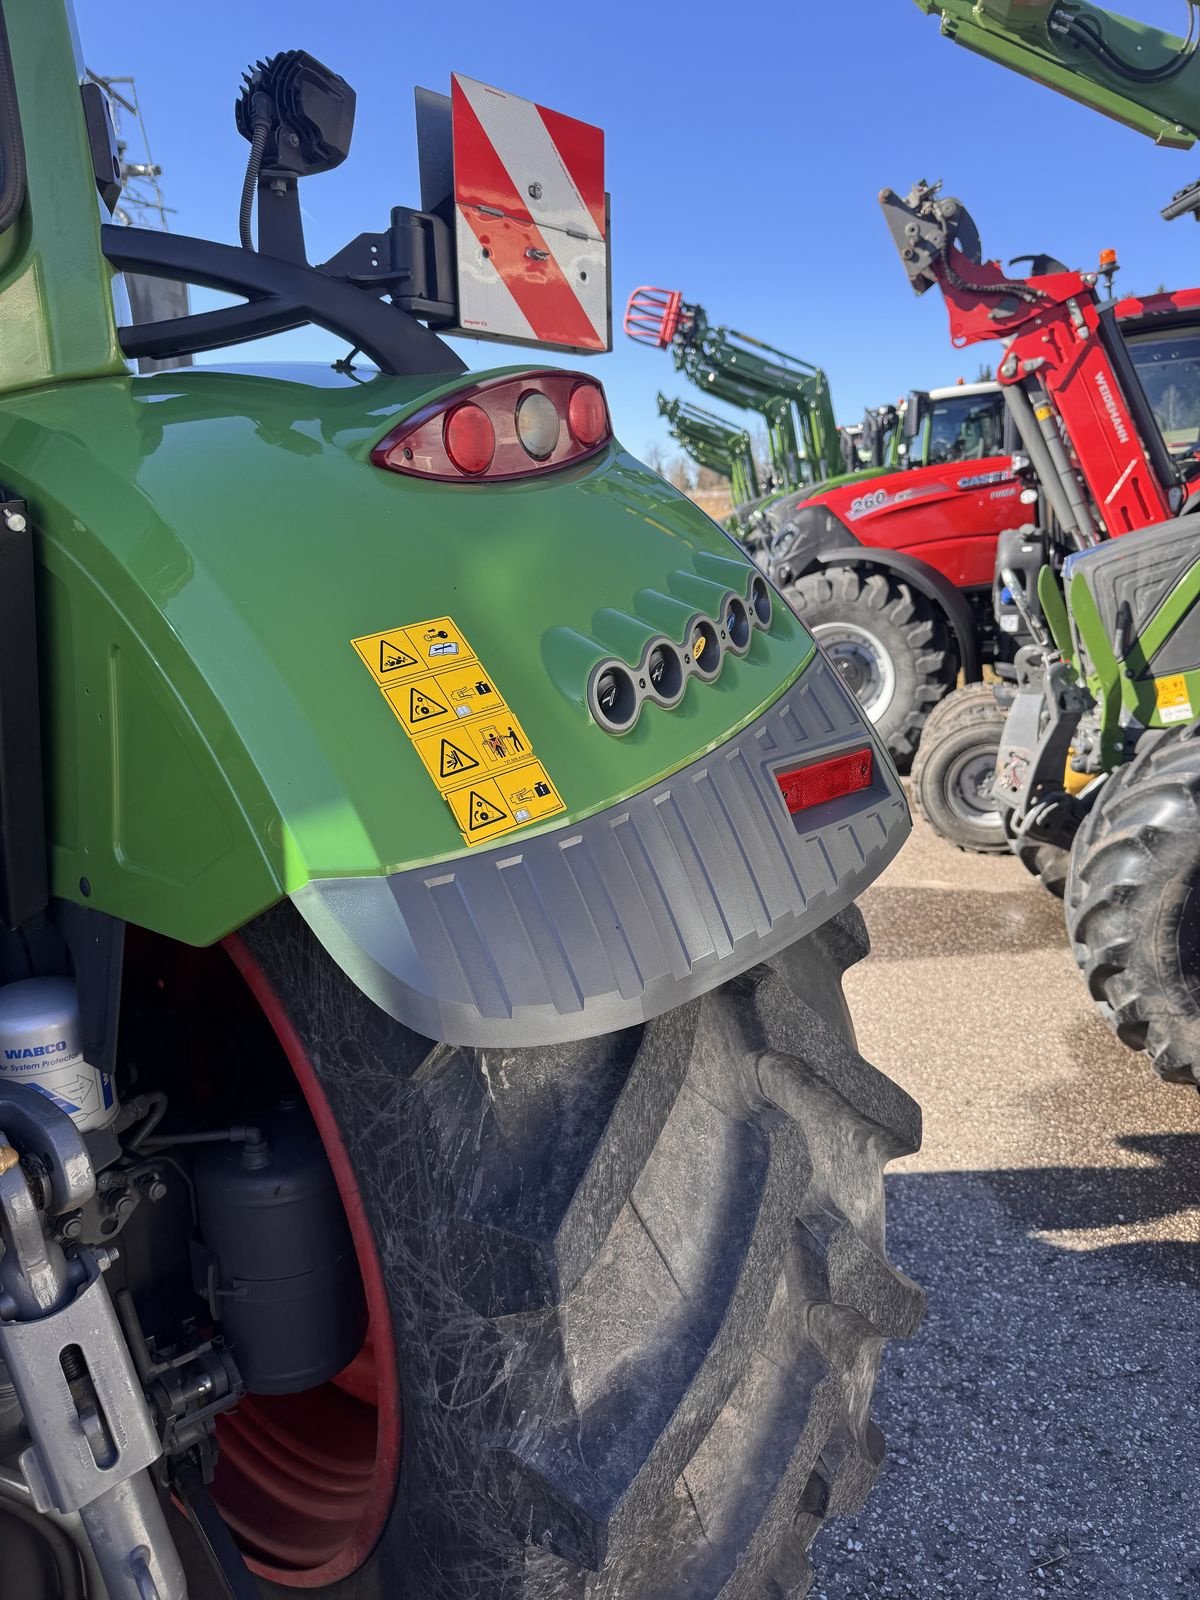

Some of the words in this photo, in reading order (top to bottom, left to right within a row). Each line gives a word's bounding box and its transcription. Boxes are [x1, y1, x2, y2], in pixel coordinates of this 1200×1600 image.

[1094, 370, 1130, 444] WEIDEMANN
[957, 472, 1002, 488] CASE
[851, 489, 887, 513] 260
[5, 1040, 67, 1060] WABCO
[10, 1063, 40, 1072] System
[42, 1052, 80, 1067] Protector
